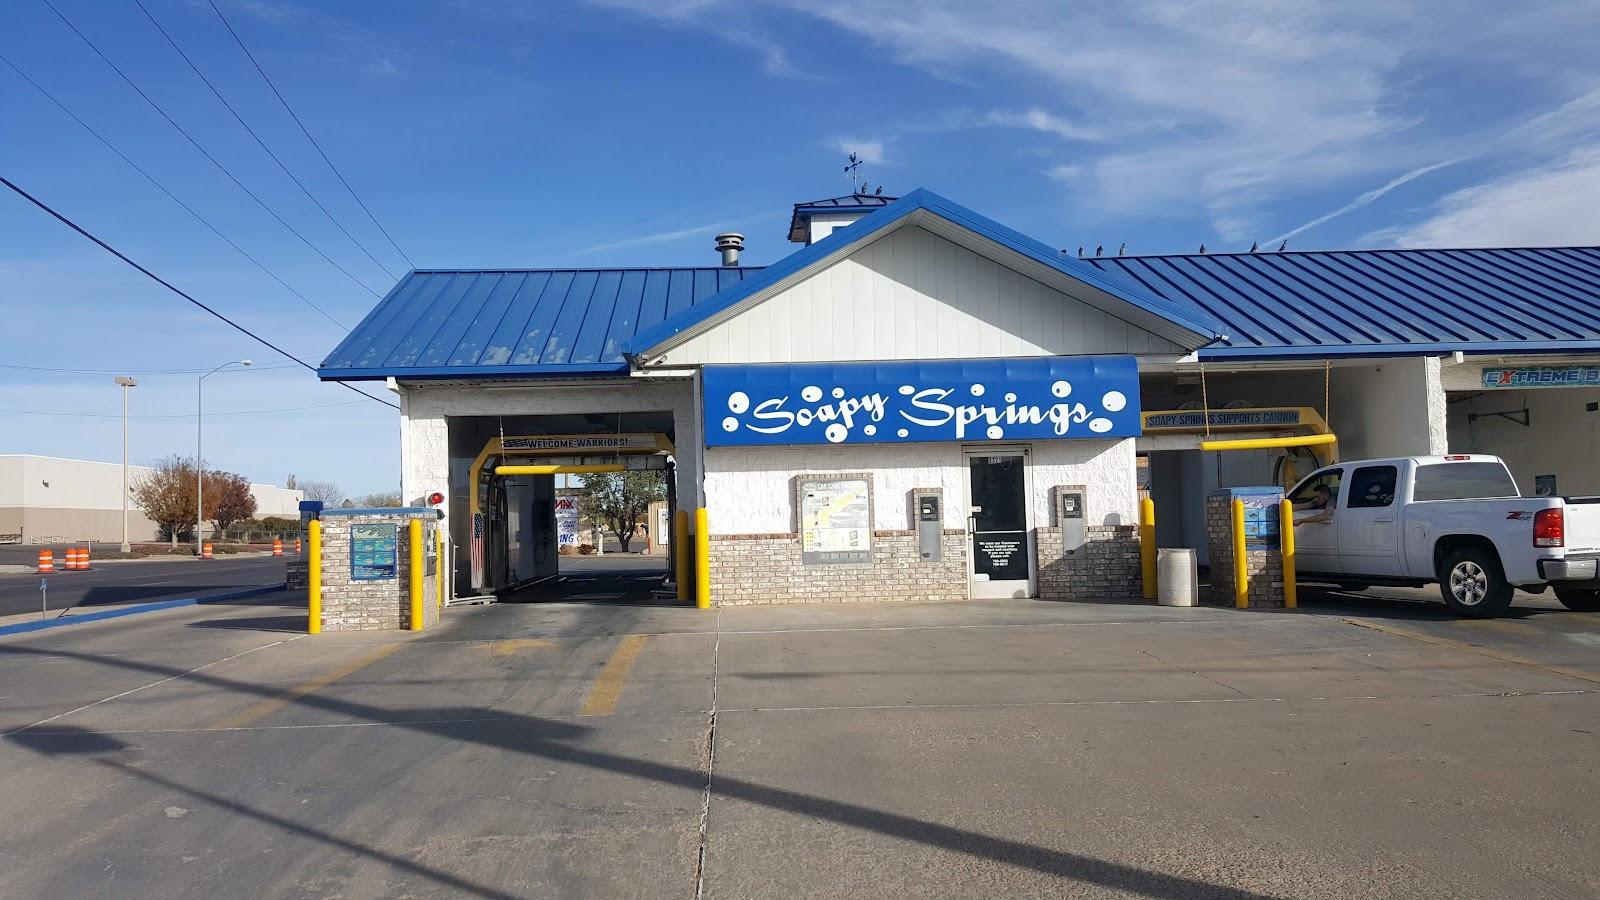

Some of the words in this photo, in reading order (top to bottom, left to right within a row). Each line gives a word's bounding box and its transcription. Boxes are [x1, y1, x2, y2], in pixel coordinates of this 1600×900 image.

[1486, 370, 1580, 385] EXTREME
[745, 391, 889, 434] Soapy
[899, 386, 1094, 439] Springs
[1150, 415, 1176, 426] SOAPY
[1217, 413, 1261, 424] SUPPORTS
[1263, 412, 1297, 423] CANNON
[527, 440, 575, 449] WELCOME
[576, 438, 628, 447] WARRIORS!
